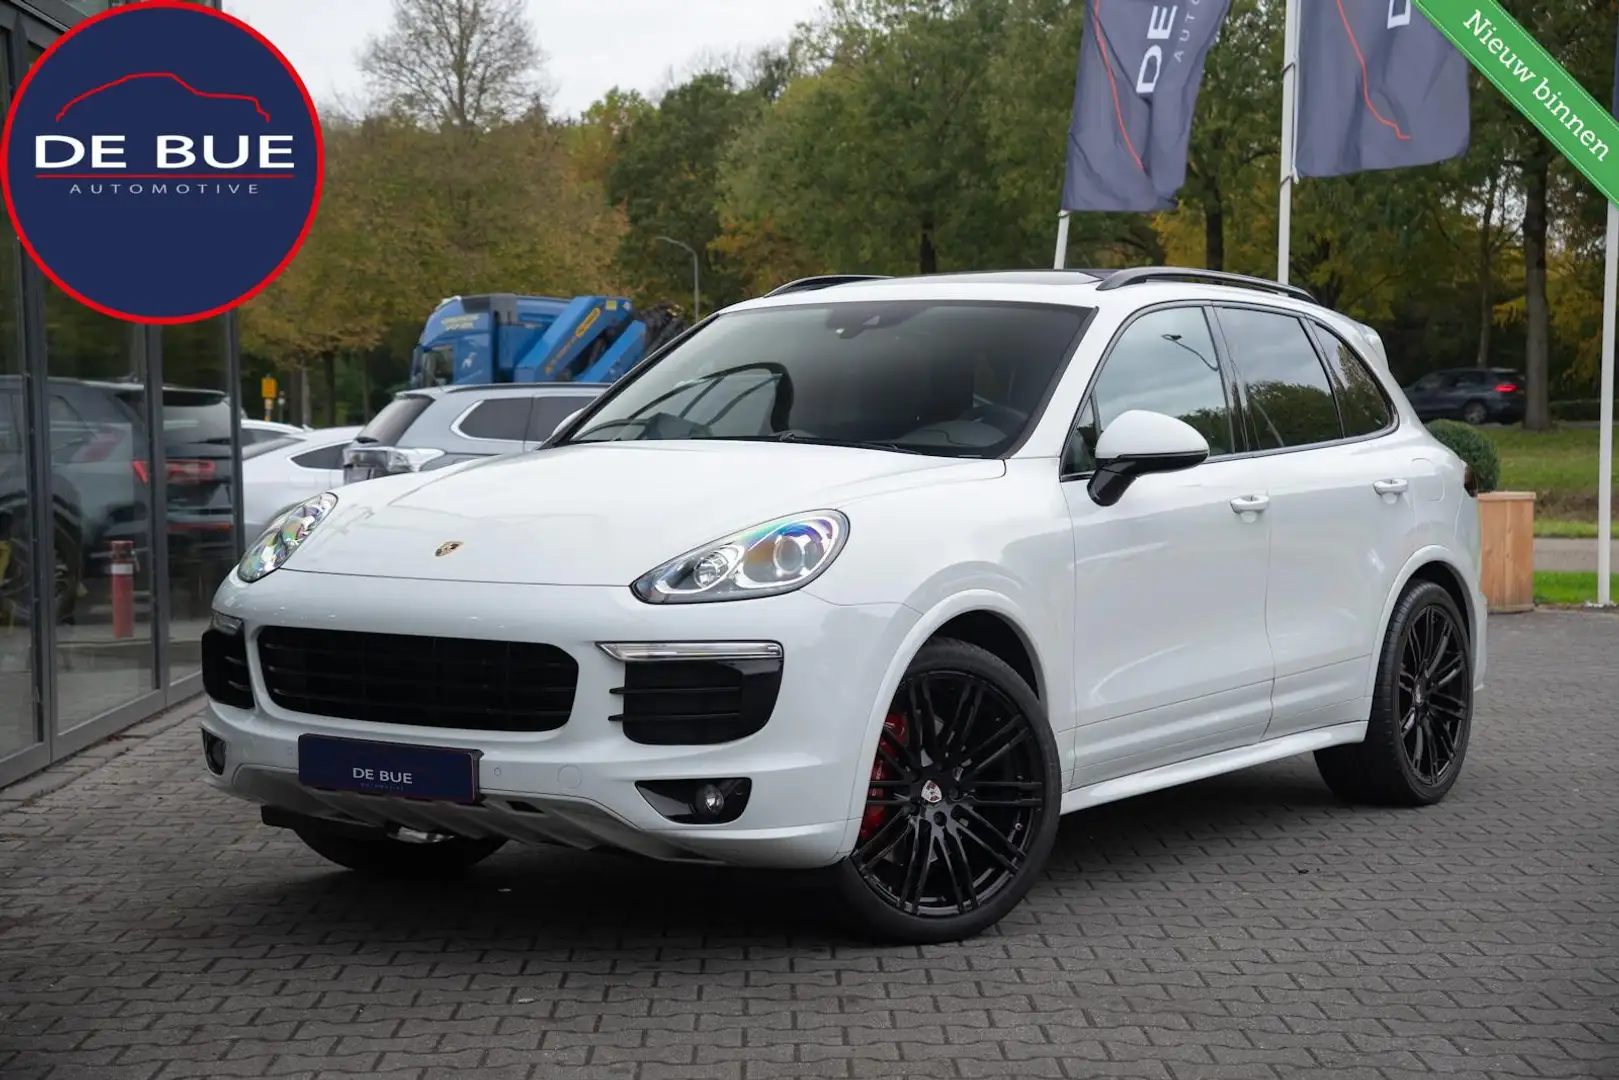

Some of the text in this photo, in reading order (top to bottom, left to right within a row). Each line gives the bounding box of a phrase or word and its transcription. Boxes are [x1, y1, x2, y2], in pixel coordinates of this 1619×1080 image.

[1136, 5, 1178, 93] DE
[352, 767, 413, 784] DE BUE
